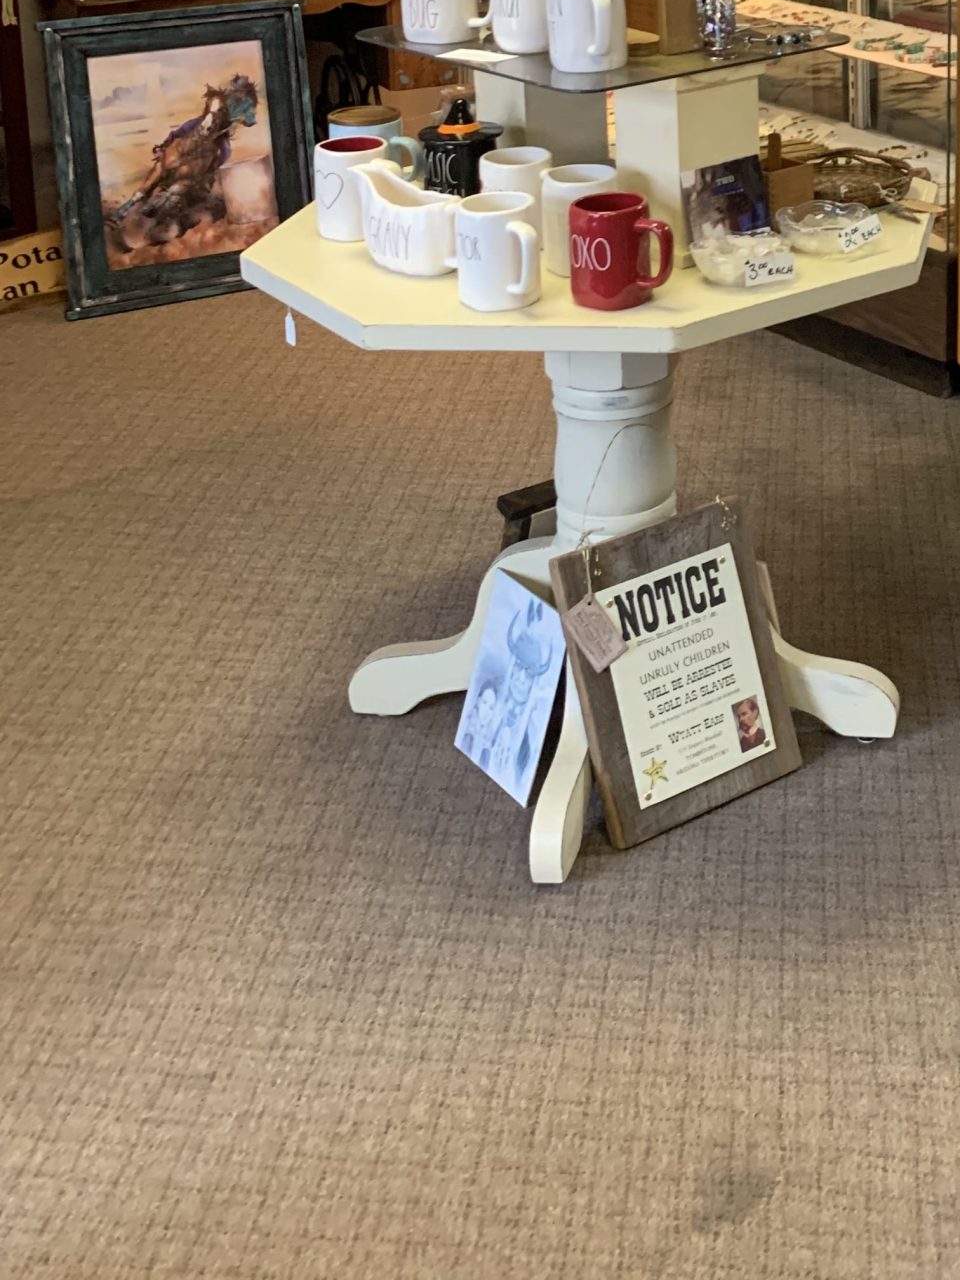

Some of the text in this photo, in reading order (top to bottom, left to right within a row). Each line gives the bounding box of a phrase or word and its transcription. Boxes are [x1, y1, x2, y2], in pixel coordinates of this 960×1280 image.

[408, 0, 440, 30] BUG
[423, 149, 458, 185] ASIC
[614, 558, 727, 642] NOTICE
[639, 639, 731, 686] UNRULY CHILDREN
[648, 627, 714, 662] UNATTENDED
[643, 656, 734, 702] WILL BE ARRESTED
[648, 709, 656, 719] &
[656, 696, 683, 716] SOLD
[684, 689, 699, 705] AS
[699, 673, 737, 698] SLAVES
